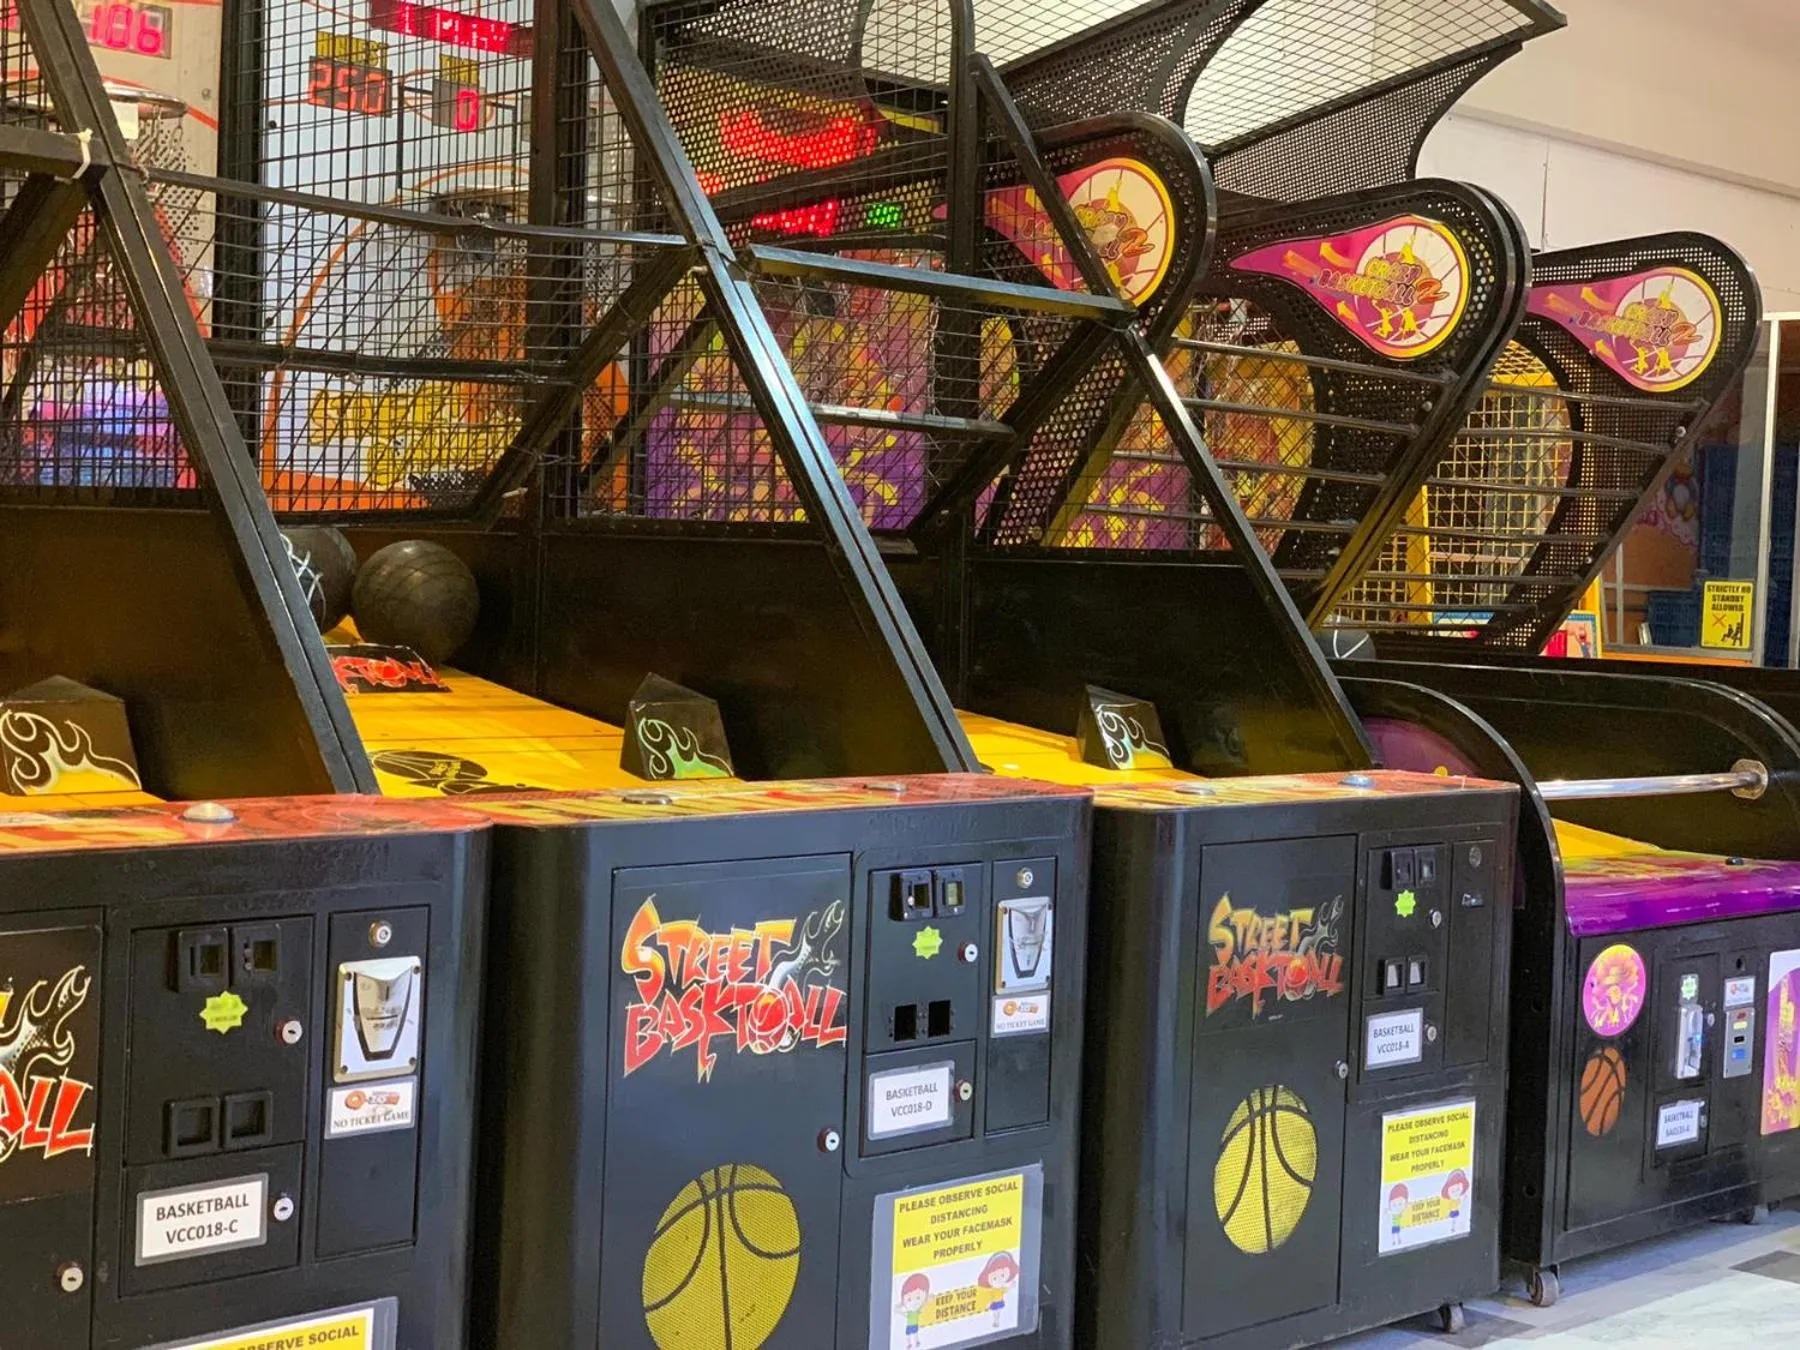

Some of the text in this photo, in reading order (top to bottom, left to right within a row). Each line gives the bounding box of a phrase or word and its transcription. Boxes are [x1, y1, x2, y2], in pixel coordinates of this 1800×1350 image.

[308, 63, 387, 116] 250
[1365, 256, 1422, 284] CRAZY
[1318, 268, 1416, 307] BASKETBALL
[1706, 584, 1740, 593] STRICTLY
[1208, 890, 1316, 967] STREET
[621, 893, 797, 1006] STREET
[1373, 1023, 1415, 1039] BASKETBALL
[886, 1082, 938, 1101] BASKETBALL
[891, 1101, 932, 1117] VCC018-D
[333, 1118, 348, 1129] NO
[349, 1113, 383, 1127] TICKET
[1387, 1121, 1413, 1133] PLEASE
[1414, 1116, 1446, 1129] OBSERVE
[1408, 1129, 1449, 1144] DISTANCING
[1390, 1141, 1466, 1162] WEAR YOUR FACEMASK
[1411, 1160, 1445, 1173] PROPERLY
[156, 1193, 250, 1221] BASKETBALL
[899, 1181, 1019, 1213] PLEASE OBSERVE SOCIAL
[930, 1204, 989, 1225] DISTANCING
[166, 1219, 239, 1245] VCC018-C
[902, 1216, 1013, 1248] WEAR YOUR FACEMASK
[932, 1240, 983, 1260] PROPERLY
[935, 1288, 978, 1306] KEEP YOUR
[935, 1300, 977, 1319] DISTANCE
[308, 1325, 359, 1345] SOCIAL
